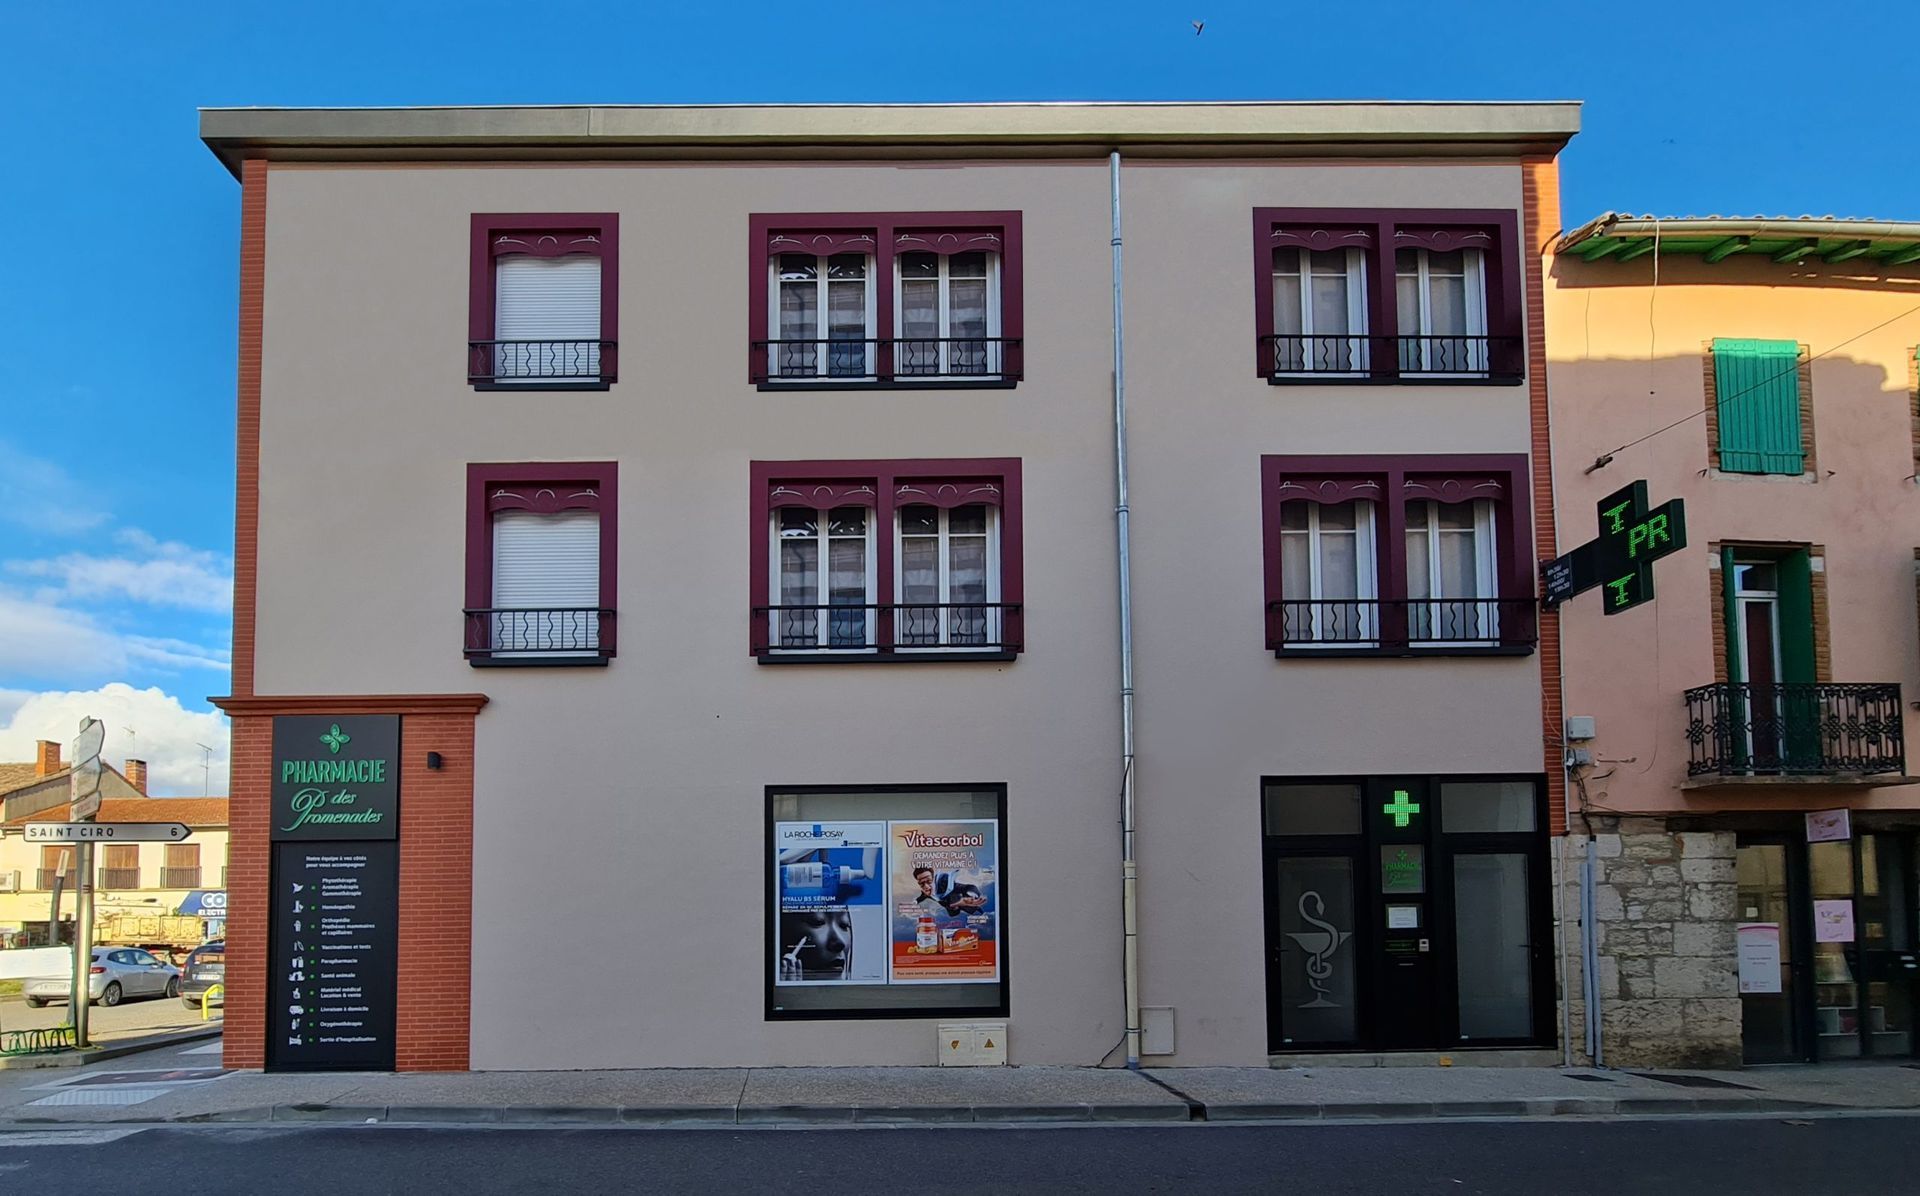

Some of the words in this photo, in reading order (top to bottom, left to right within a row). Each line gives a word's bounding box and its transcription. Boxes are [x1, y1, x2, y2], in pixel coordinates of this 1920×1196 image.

[282, 760, 386, 783] PHARMACIE
[331, 789, 357, 804] des
[280, 788, 383, 832] Promenades
[30, 827, 73, 838] SAINT
[80, 827, 114, 837] CIRQ
[170, 827, 178, 837] 6
[899, 830, 983, 847] Vitascorbol
[913, 852, 948, 860] DEMANDEZ
[934, 860, 966, 868] VITAMINE
